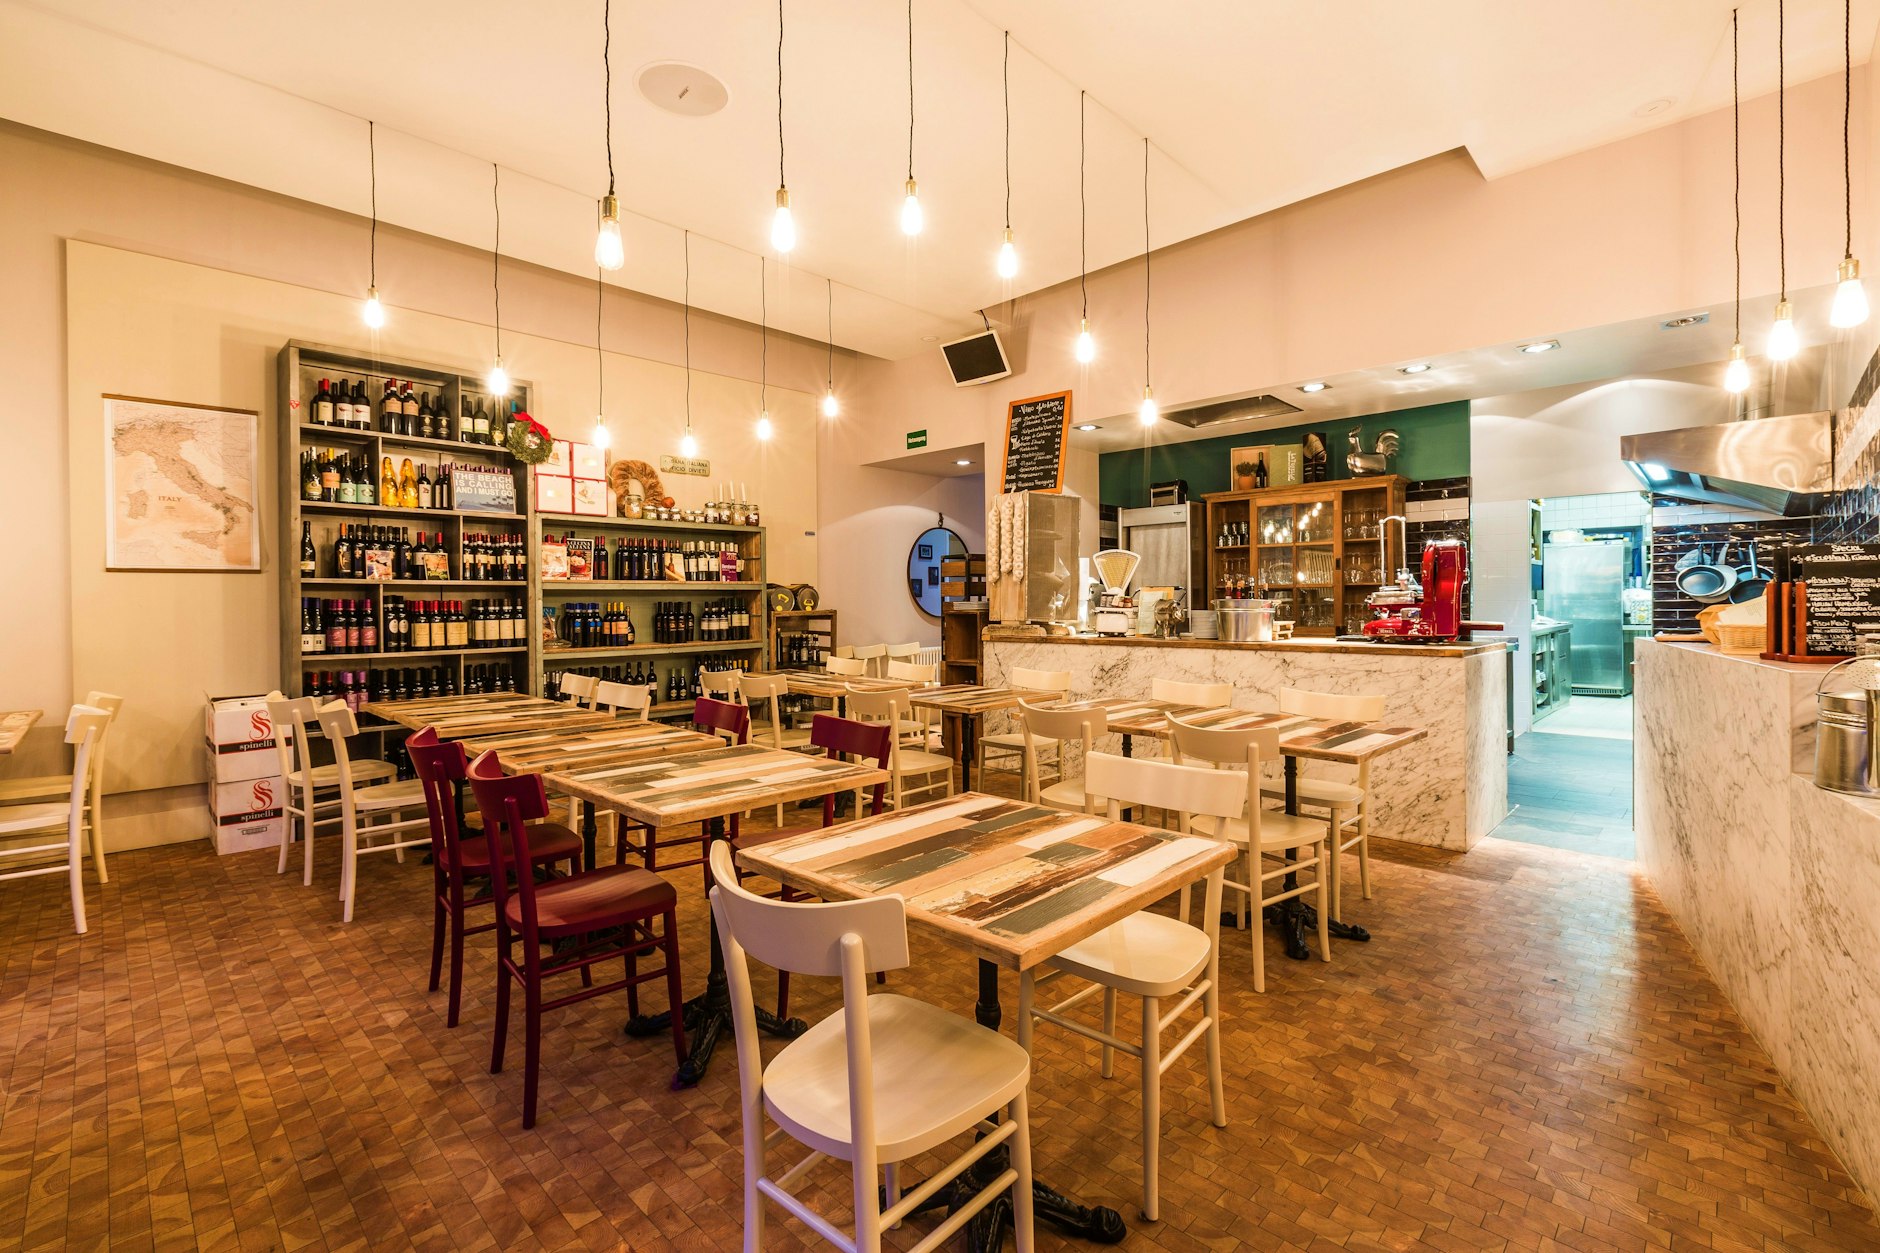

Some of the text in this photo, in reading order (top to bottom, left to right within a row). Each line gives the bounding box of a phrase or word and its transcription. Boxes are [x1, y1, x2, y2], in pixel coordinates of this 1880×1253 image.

[478, 474, 511, 483] BEACH
[469, 481, 511, 490] CALLING
[240, 740, 273, 751] spinelli
[240, 810, 274, 822] spinelli
